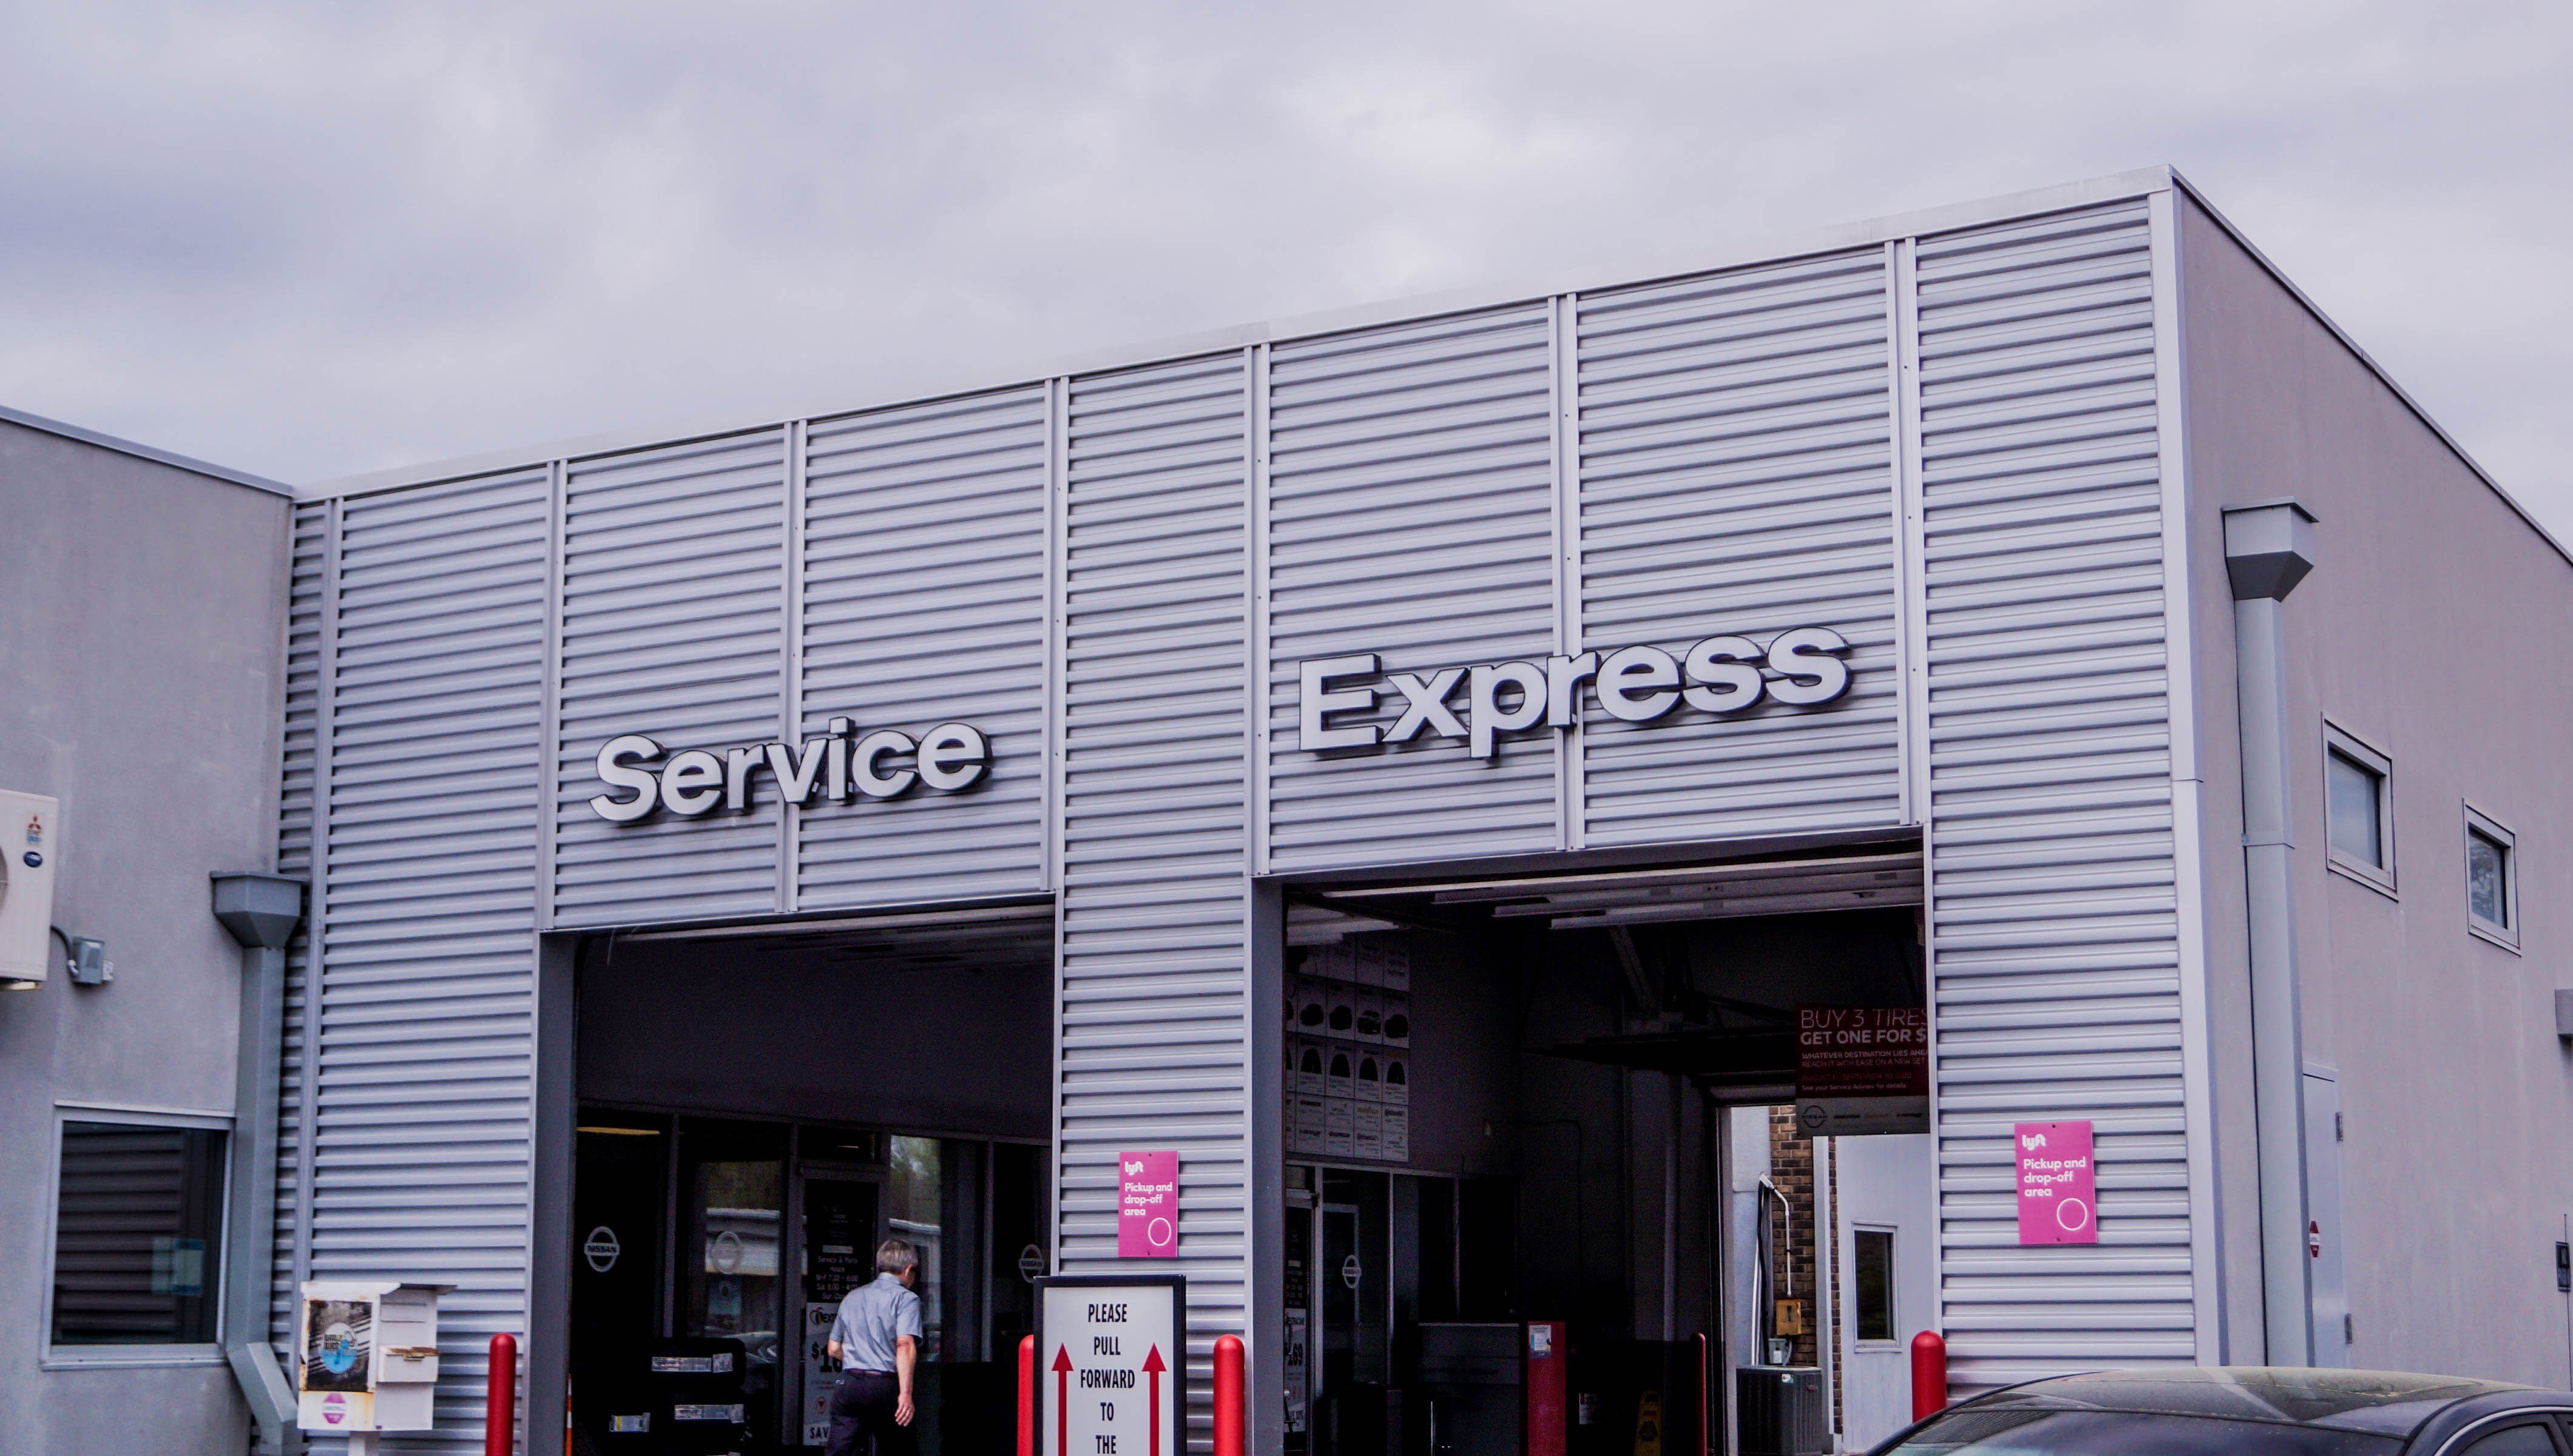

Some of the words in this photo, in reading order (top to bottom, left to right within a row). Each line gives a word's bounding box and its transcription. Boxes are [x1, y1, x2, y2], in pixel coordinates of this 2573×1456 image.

[1299, 626, 1854, 760] Express
[589, 716, 993, 824] Service
[1800, 1009, 1847, 1029] BUY
[1851, 1009, 1865, 1027] 3
[1800, 1031, 1833, 1045] GET
[1836, 1030, 1872, 1044] ONE
[1876, 1028, 1912, 1043] FOR
[2021, 1133, 2046, 1151] lyft
[1124, 1161, 1143, 1176] lyft
[2023, 1158, 2061, 1172] Pickup
[2064, 1156, 2086, 1168] and
[2024, 1171, 2074, 1186] drop-off
[1124, 1181, 1154, 1194] Pickup
[1155, 1181, 1172, 1192] and
[2024, 1187, 2052, 1197] area
[1124, 1193, 1163, 1206] drop-off
[1124, 1207, 1146, 1216] area
[817, 1255, 837, 1264] Service
[1087, 1303, 1128, 1324] PLEASE
[1094, 1336, 1121, 1357] PULL
[1080, 1369, 1135, 1389] FORWARD
[1100, 1401, 1115, 1421] TO
[810, 1427, 830, 1440] SAV
[1095, 1434, 1117, 1455] THE
